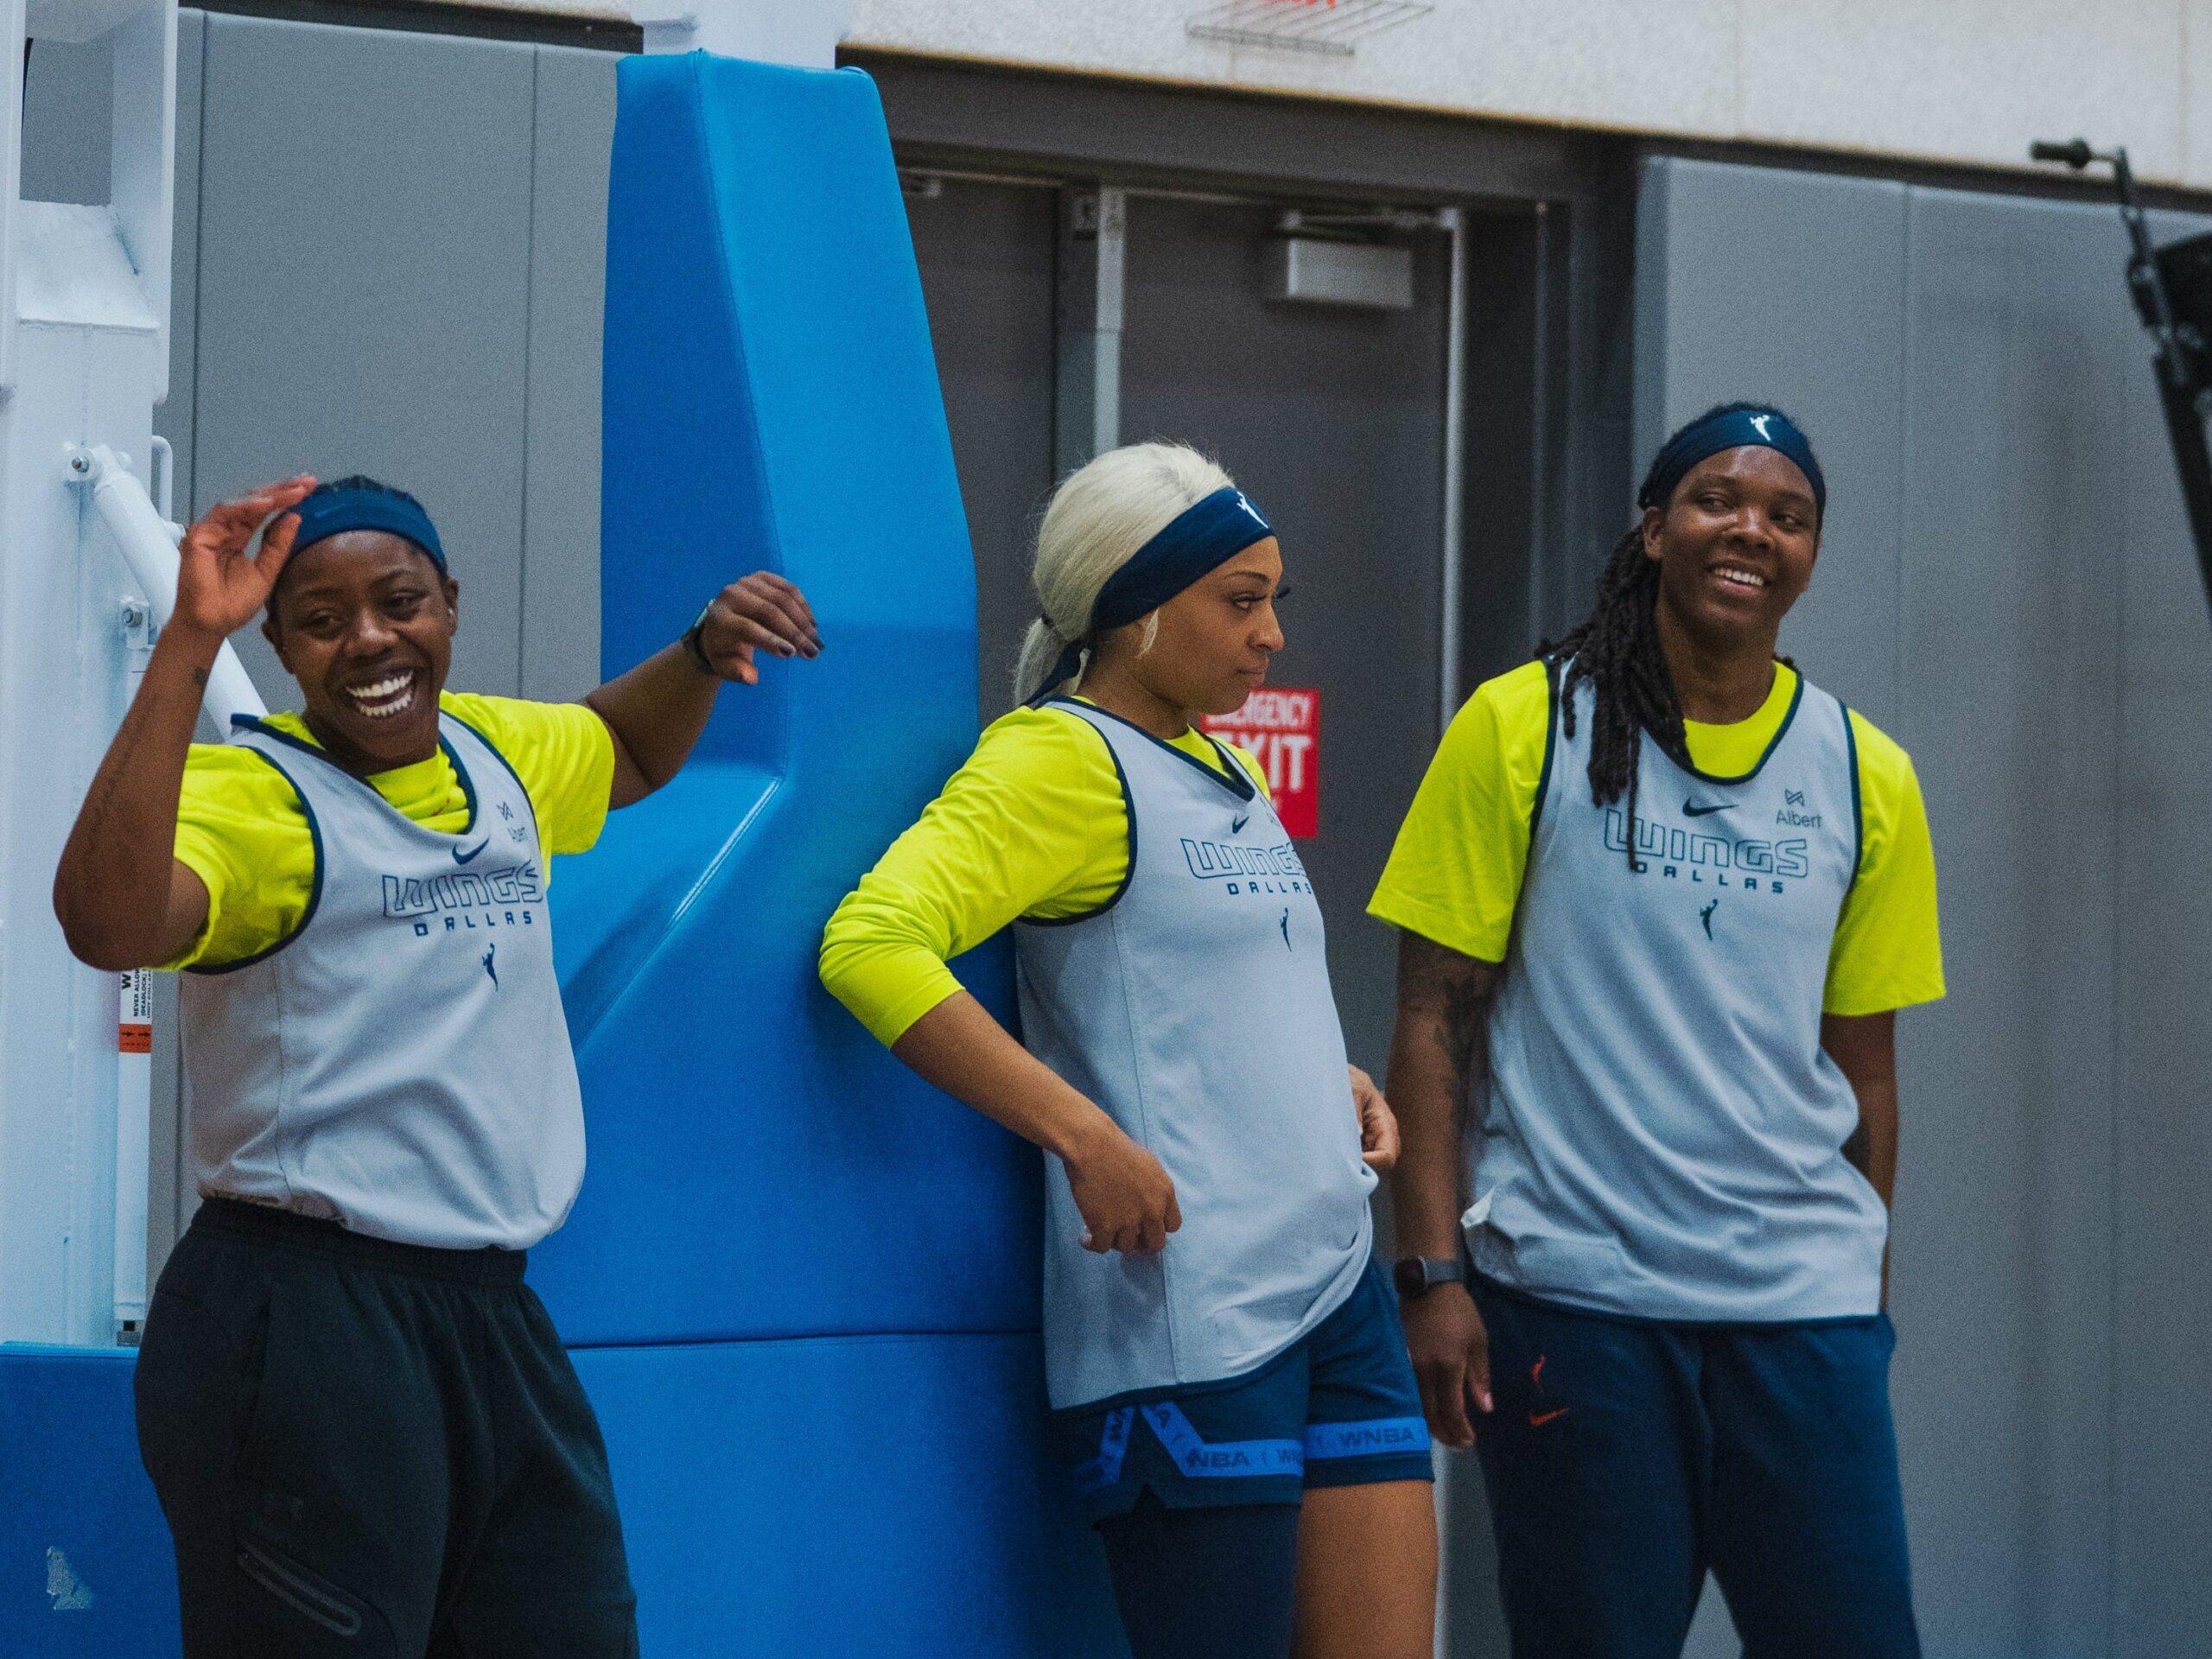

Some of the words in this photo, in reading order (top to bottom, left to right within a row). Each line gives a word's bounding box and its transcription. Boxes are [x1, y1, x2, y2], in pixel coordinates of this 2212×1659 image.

[1207, 692, 1311, 727] RGENCY
[1209, 733, 1311, 792] IT
[1776, 810, 1822, 829] Albert
[1604, 808, 1808, 878] WINGS
[382, 858, 543, 918] WINGS
[1227, 881, 1312, 895] DALLAS
[1634, 861, 1784, 893] DALLAS
[414, 911, 532, 937] DALLAS
[1339, 1427, 1416, 1446] WNBA
